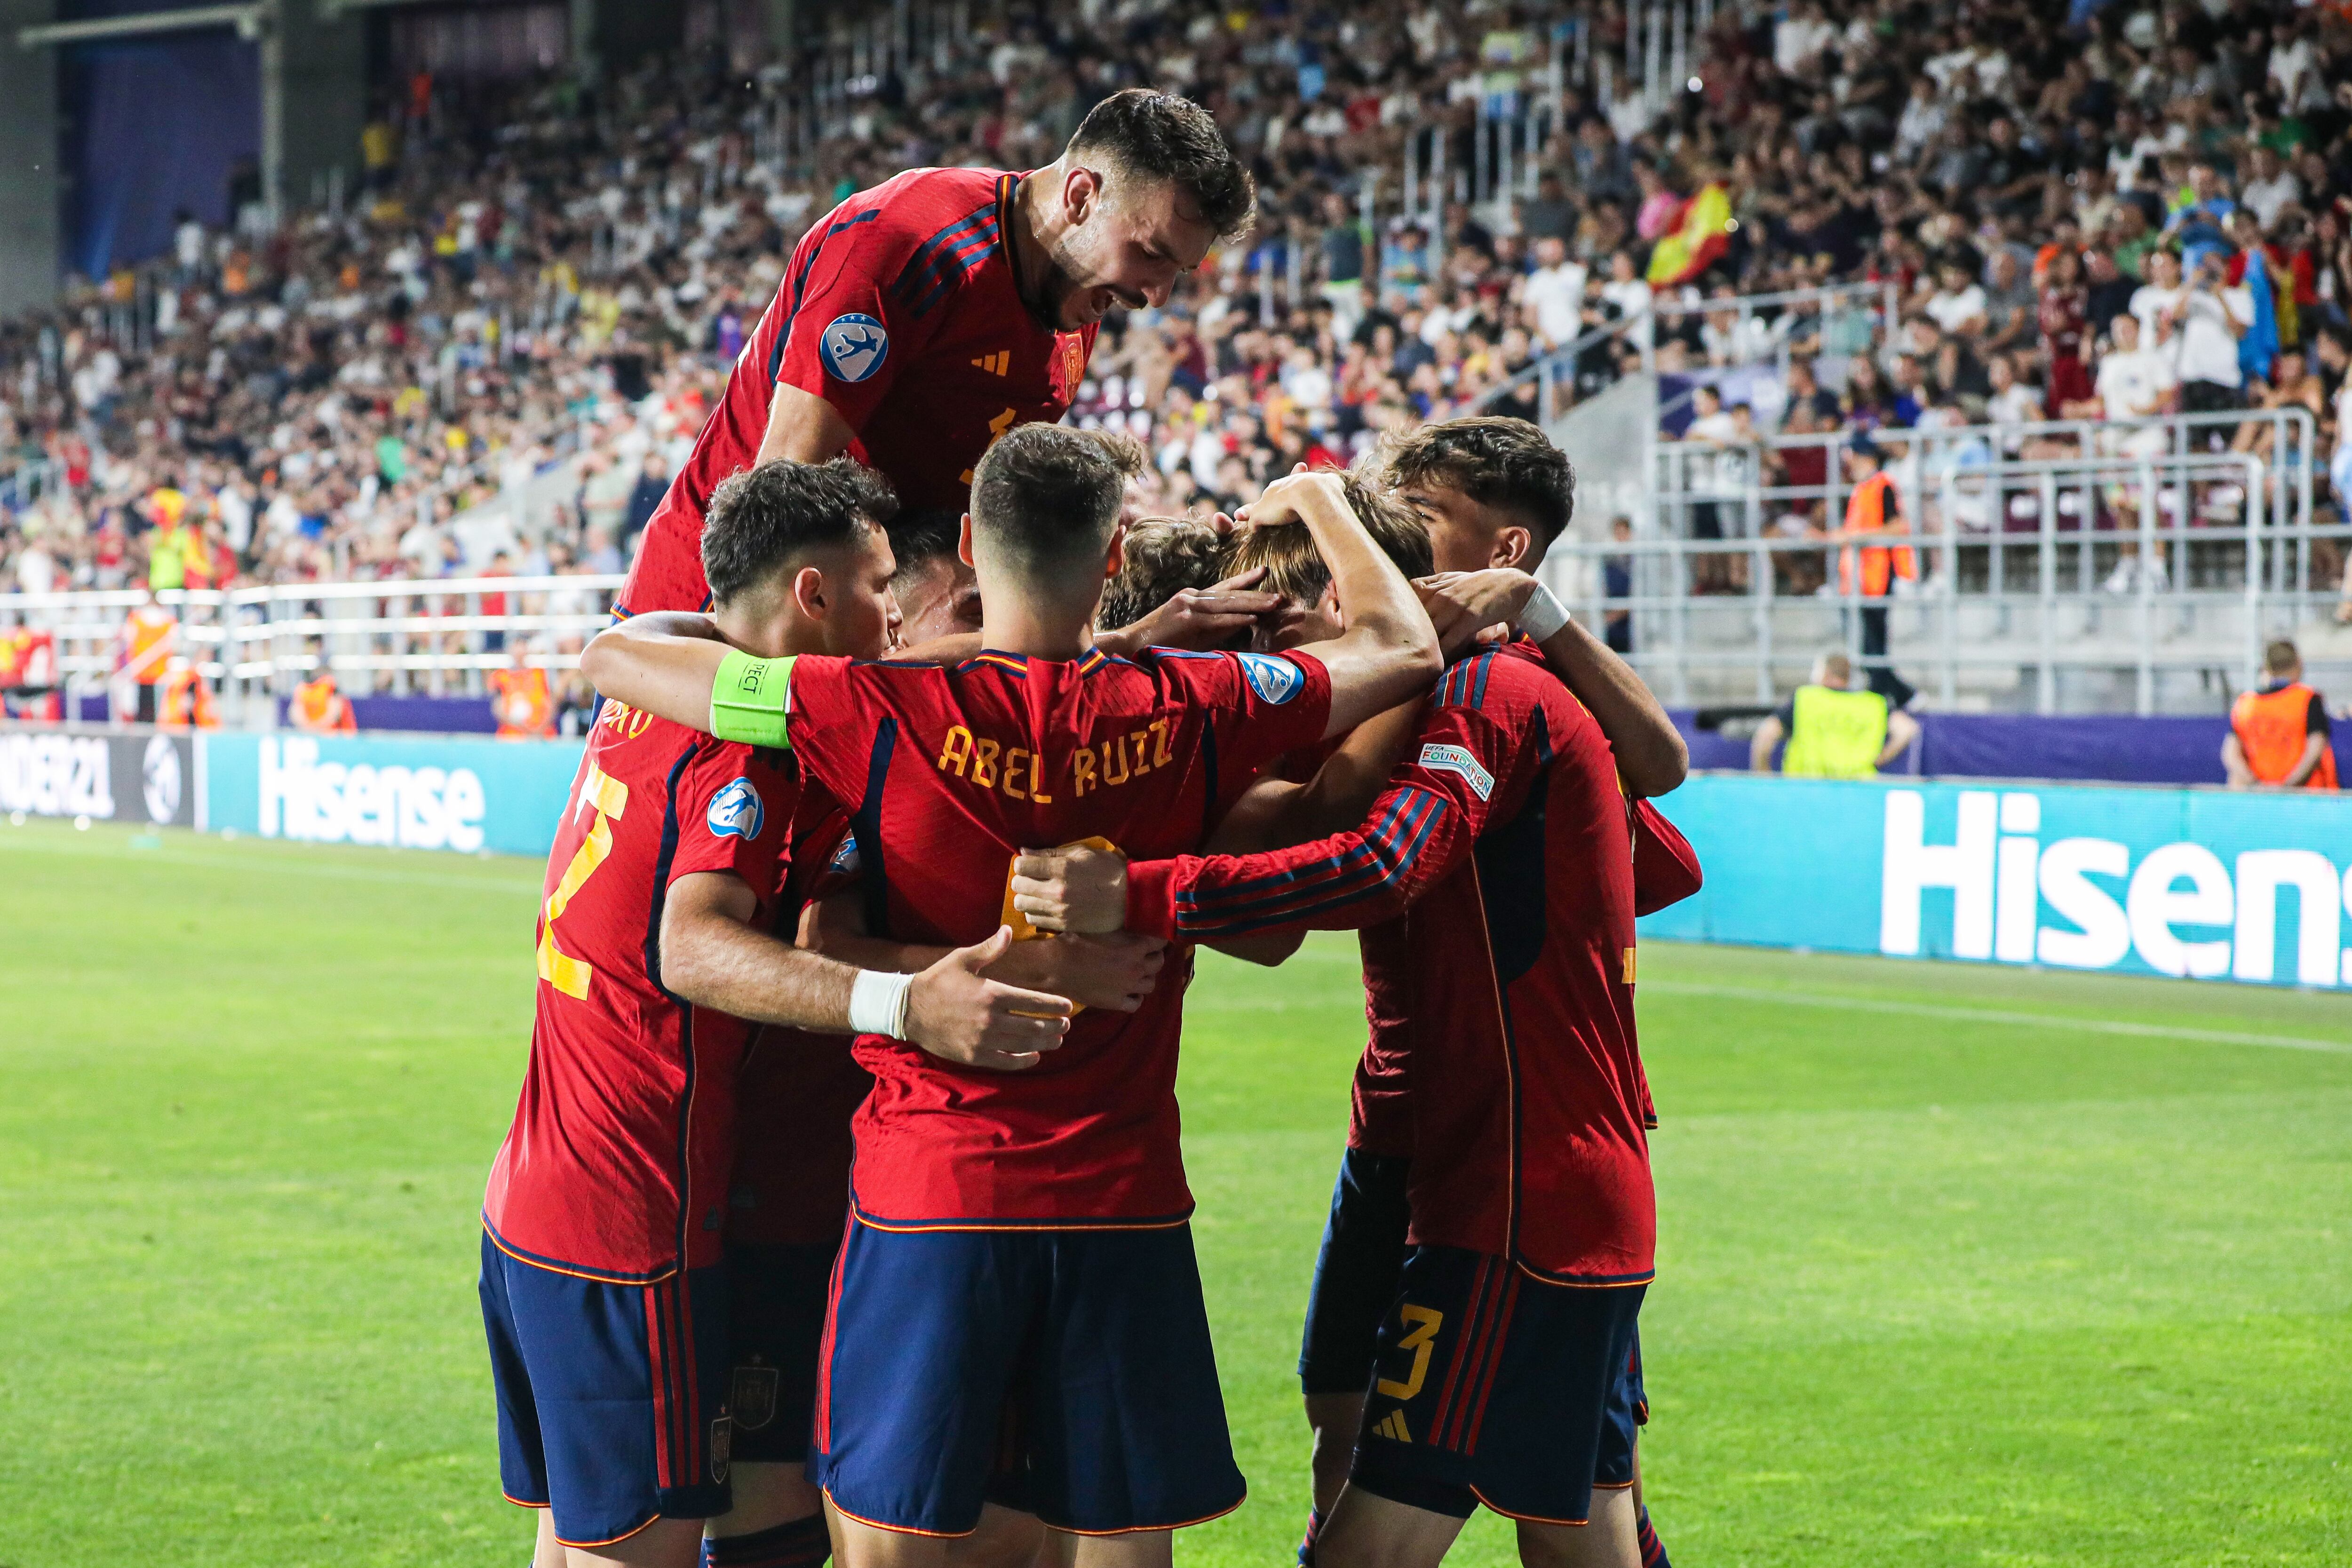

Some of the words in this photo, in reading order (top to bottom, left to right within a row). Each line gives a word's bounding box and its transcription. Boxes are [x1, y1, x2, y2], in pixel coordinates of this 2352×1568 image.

[258, 736, 485, 853] Hisense
[938, 725, 1052, 804] ABEL
[1074, 716, 1173, 797] RUIZ
[1422, 751, 1491, 793] FOUNDATION
[1880, 789, 2352, 987] Hisen
[1377, 1303, 1443, 1401] 3
